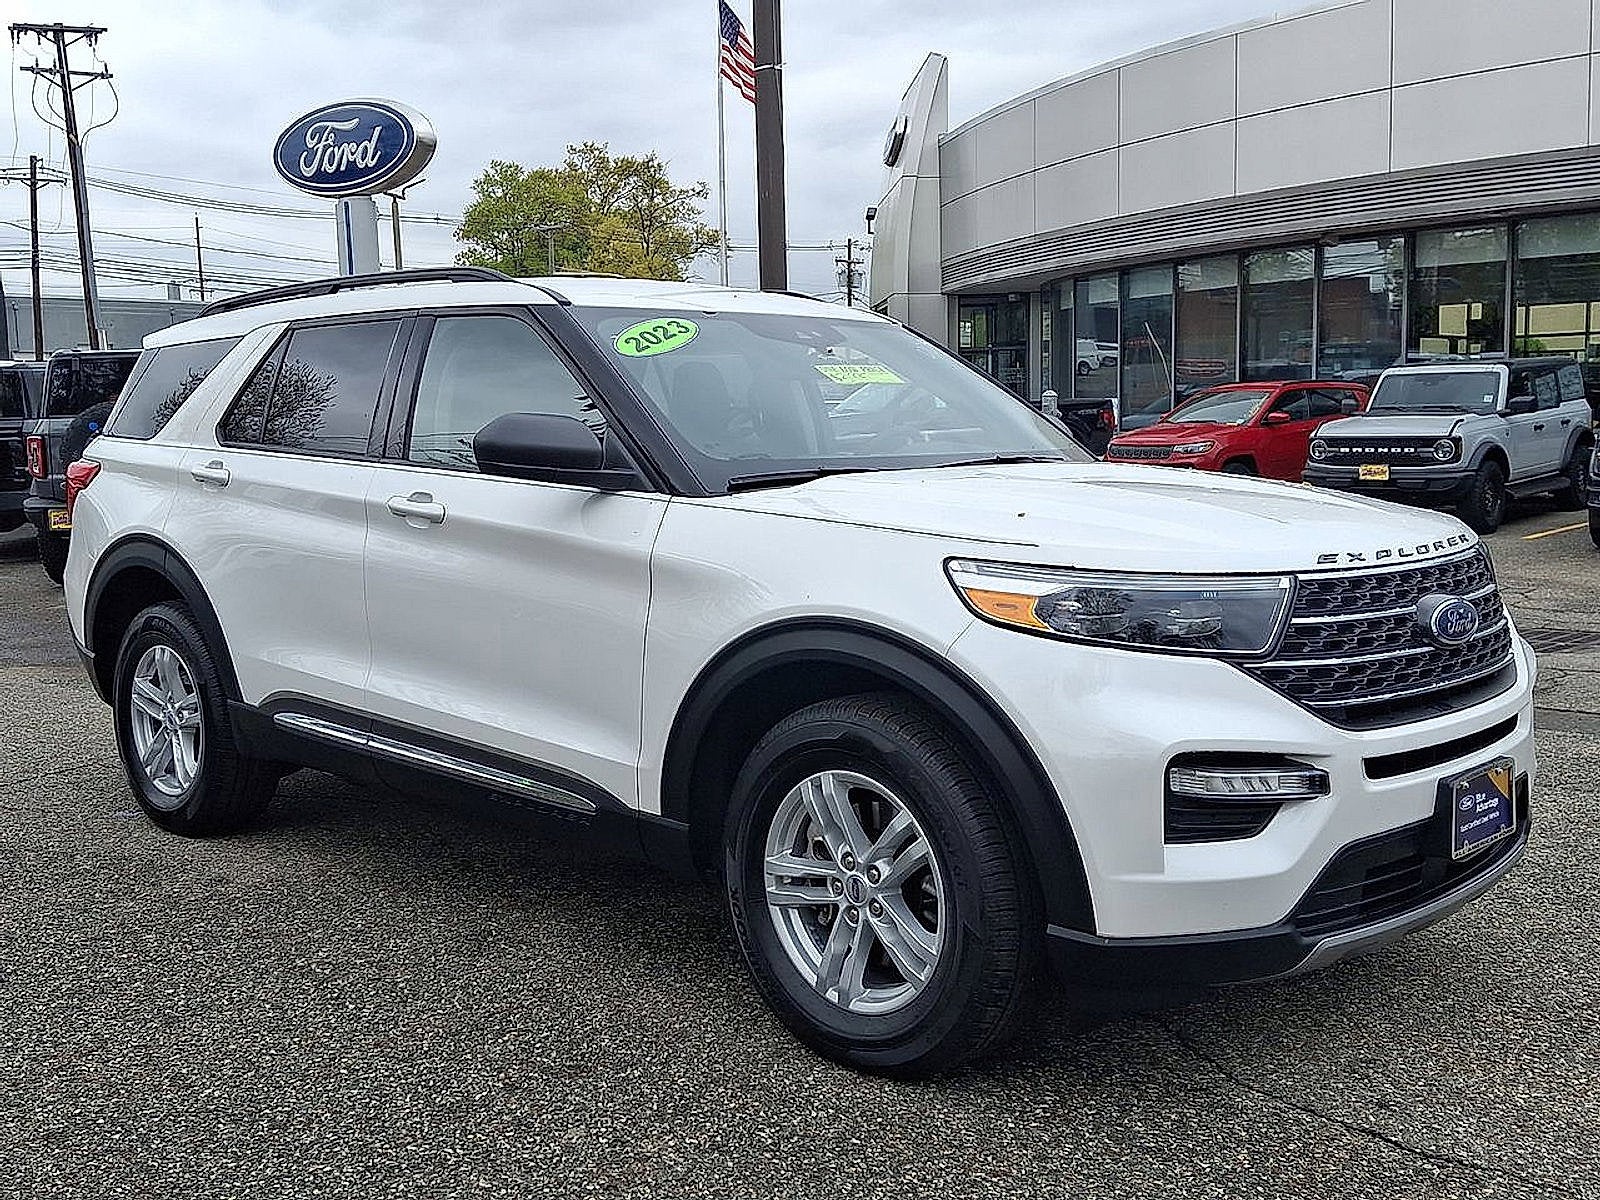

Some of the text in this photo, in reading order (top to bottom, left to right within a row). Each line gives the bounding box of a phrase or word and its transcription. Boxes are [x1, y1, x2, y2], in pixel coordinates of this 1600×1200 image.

[300, 118, 383, 177] Ford
[625, 320, 690, 353] 2023
[1317, 533, 1470, 564] EXPLORER
[1447, 607, 1473, 634] Ford
